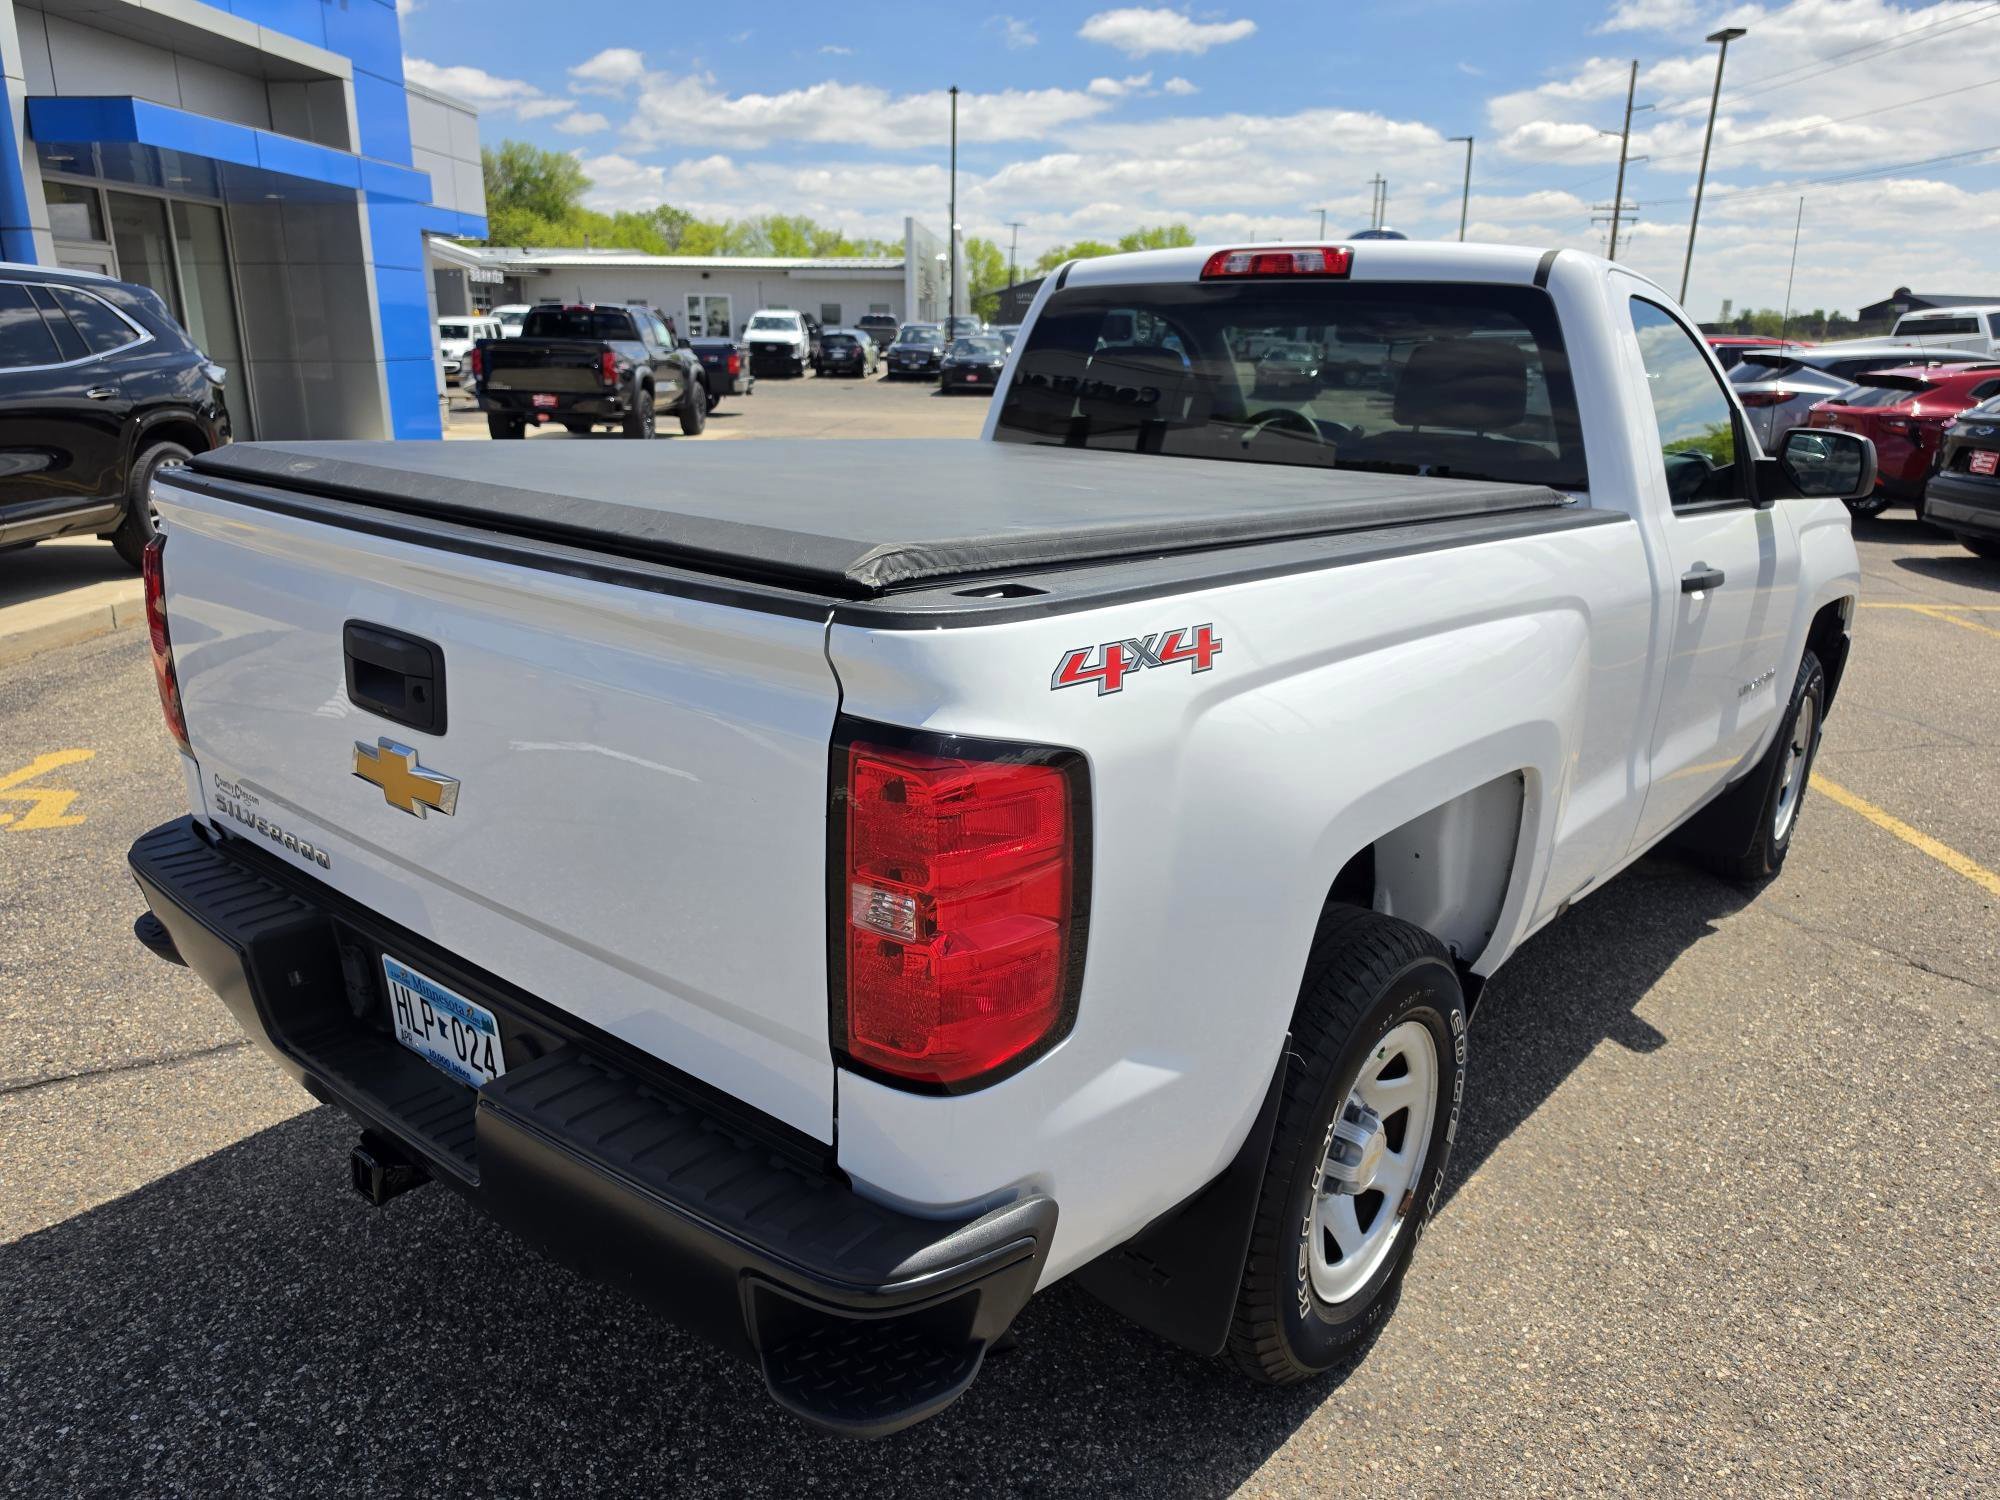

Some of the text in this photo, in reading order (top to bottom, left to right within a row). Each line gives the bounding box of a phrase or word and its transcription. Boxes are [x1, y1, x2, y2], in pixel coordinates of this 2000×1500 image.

[215, 793, 330, 870] SILVERADO
[392, 981, 497, 1078] HLP 024
[411, 975, 465, 1015] Minnesota
[1445, 1008, 1464, 1145] EDGE
